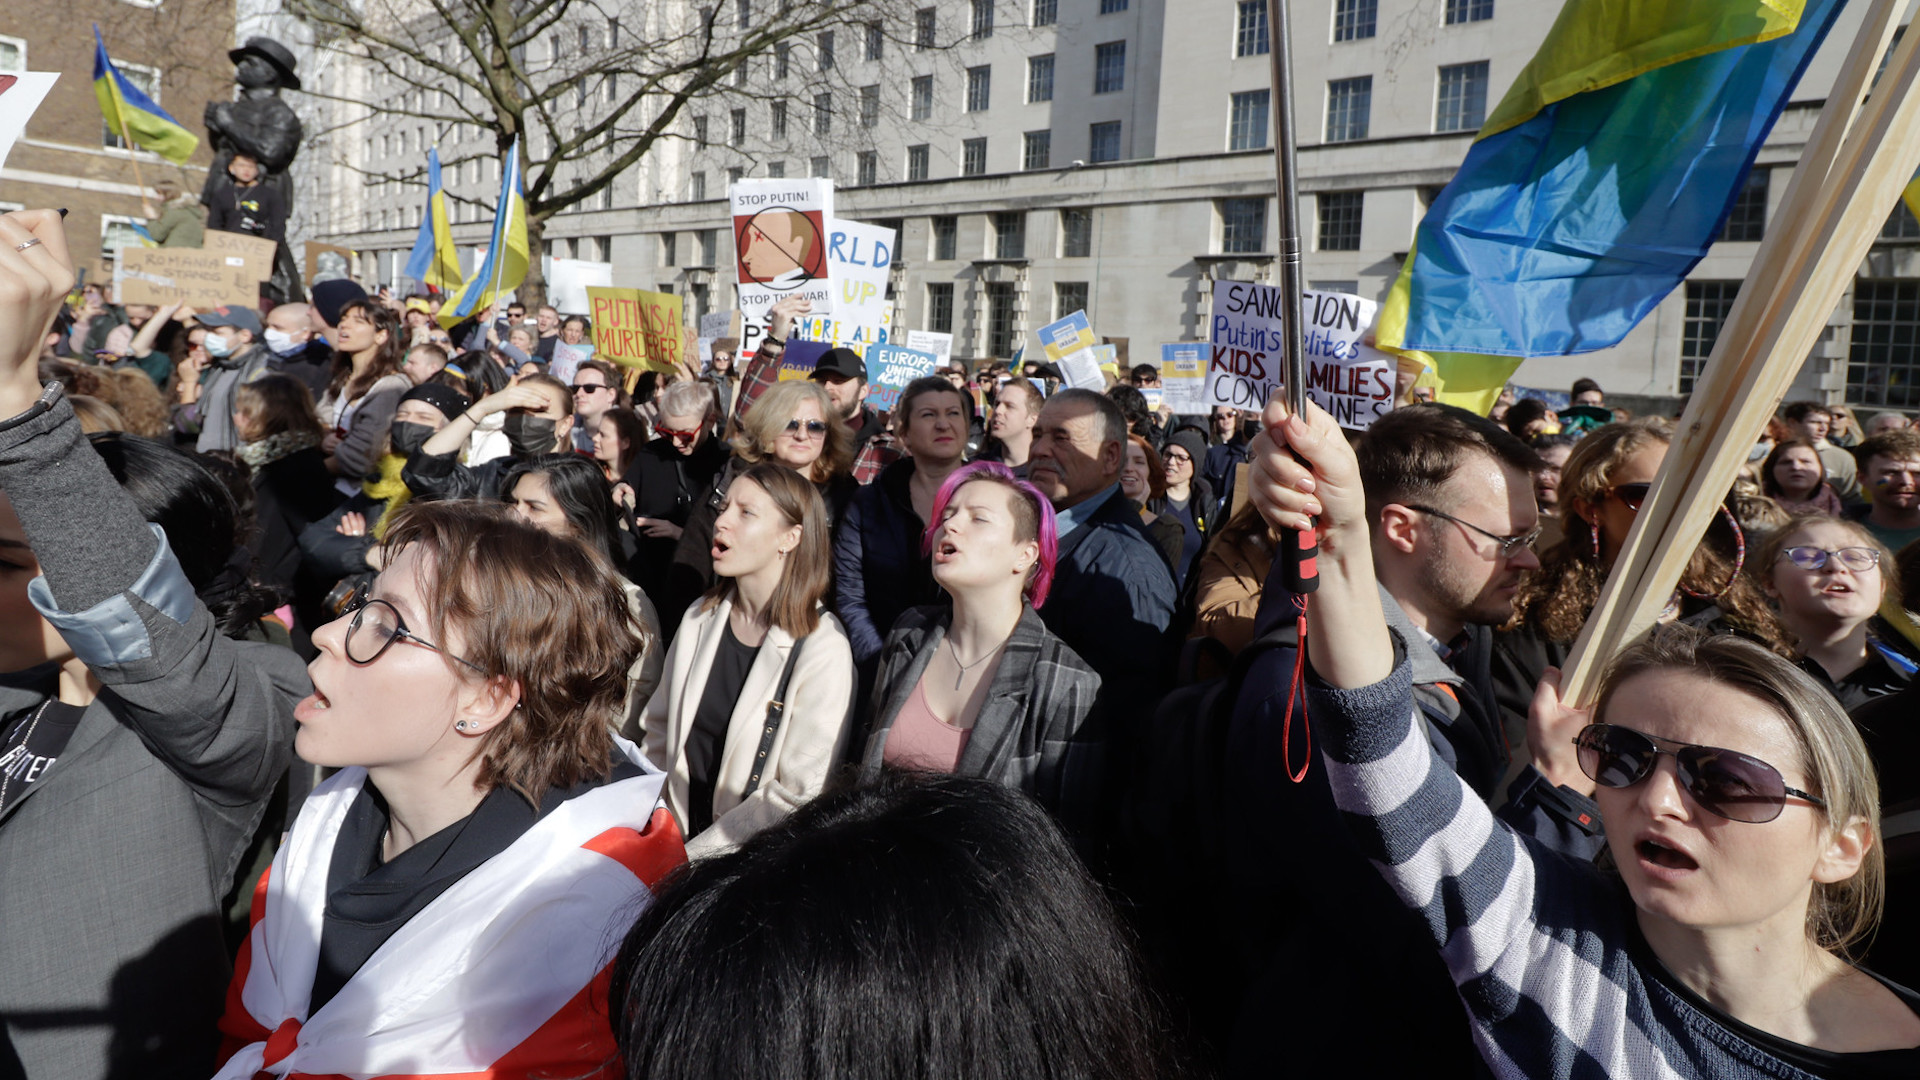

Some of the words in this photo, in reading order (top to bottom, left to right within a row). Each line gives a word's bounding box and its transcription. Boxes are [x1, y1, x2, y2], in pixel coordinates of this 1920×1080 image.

[738, 194, 768, 206] STOP
[770, 191, 809, 202] PUTIN!
[216, 235, 266, 257] SAVE
[145, 253, 220, 269] ROMANIA
[148, 285, 192, 298] WITH
[198, 287, 230, 301] YOU
[741, 293, 770, 306] STOP
[842, 278, 877, 305] UP
[594, 297, 651, 333] PUTIN
[666, 307, 678, 338] A
[802, 317, 841, 341] MORE
[852, 325, 888, 345] AID
[1213, 315, 1281, 352] Putin's
[596, 327, 678, 365] MURDERER
[879, 349, 934, 374] EUROPE
